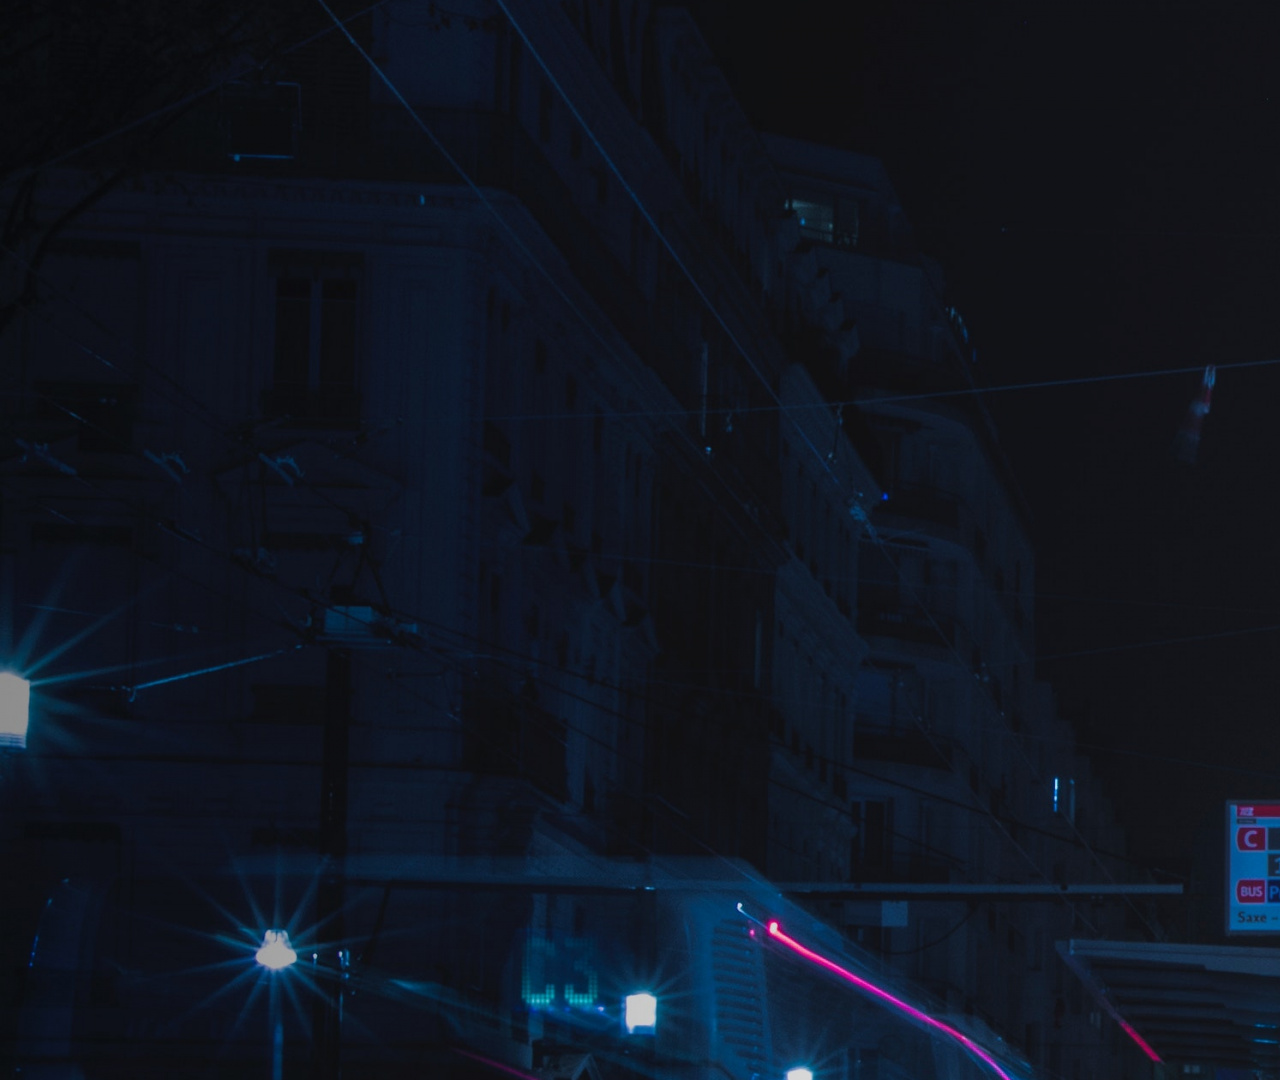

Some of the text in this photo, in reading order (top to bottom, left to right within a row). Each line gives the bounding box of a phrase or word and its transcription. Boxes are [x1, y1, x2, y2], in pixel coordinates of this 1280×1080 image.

[1244, 830, 1258, 848] C
[1240, 886, 1263, 898] BUS
[1237, 911, 1266, 922] Saxe
